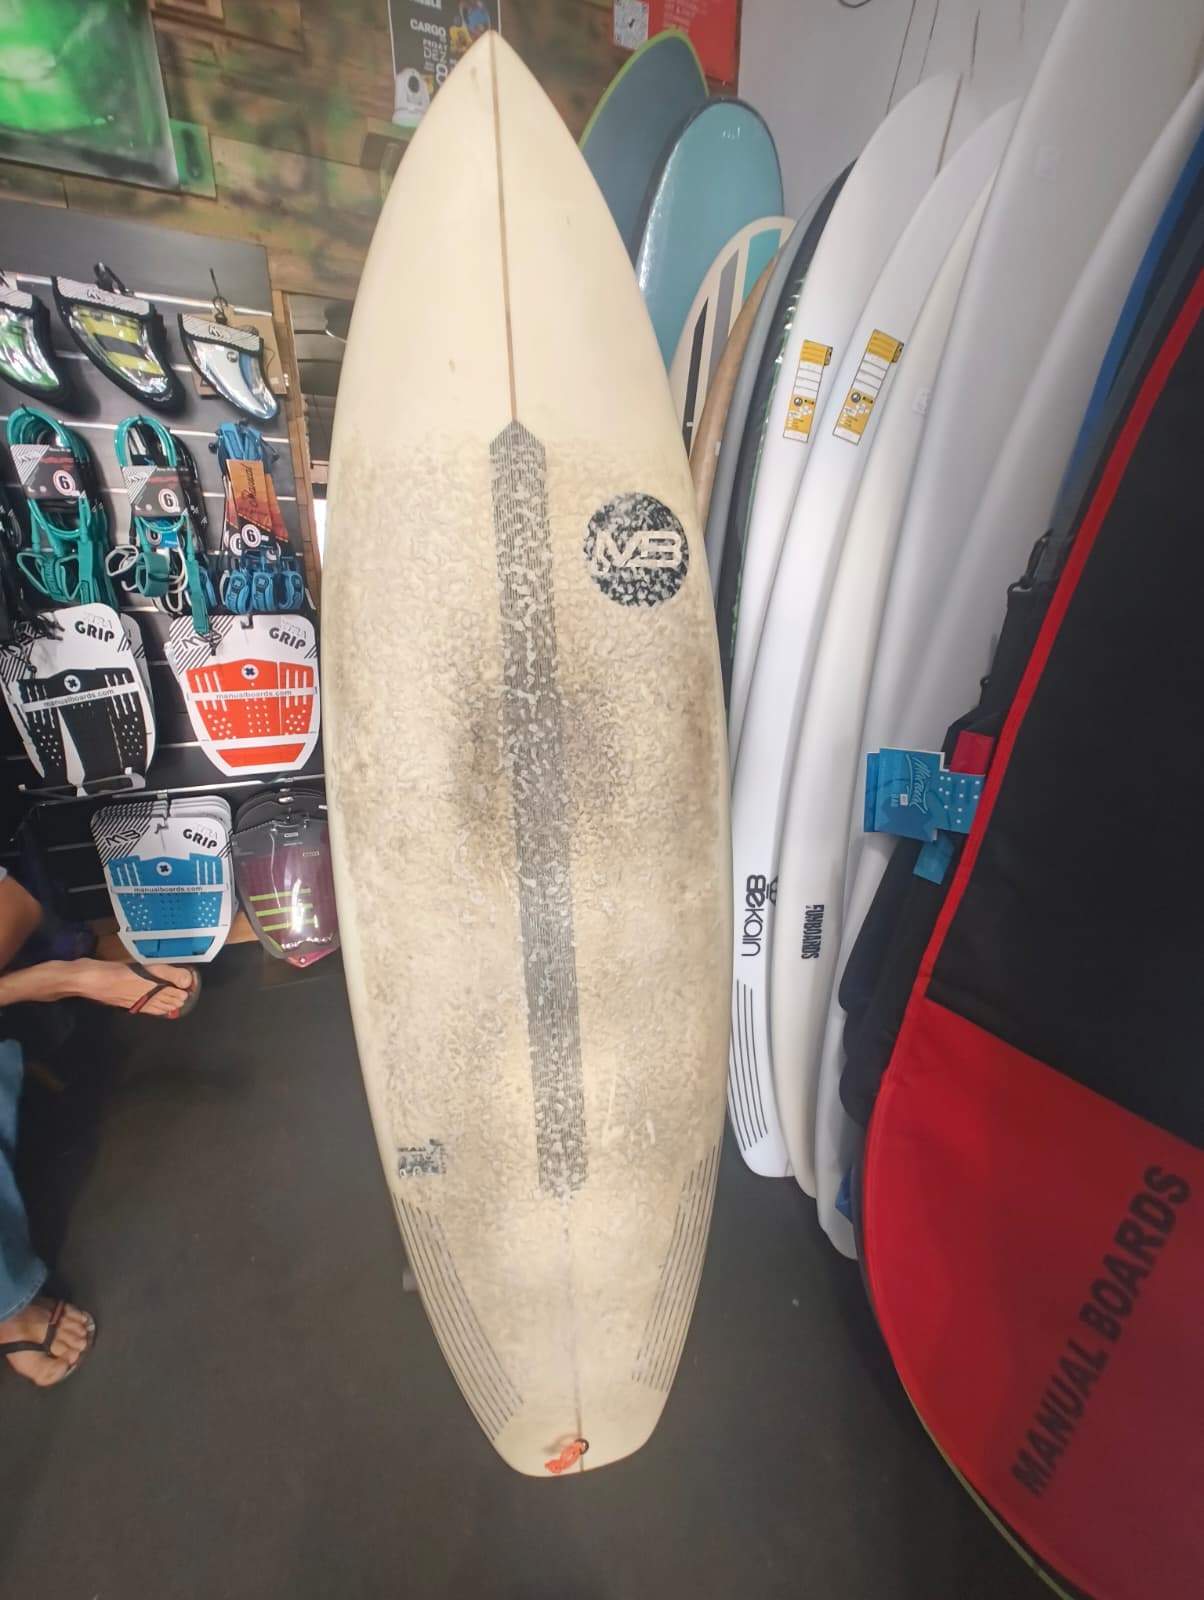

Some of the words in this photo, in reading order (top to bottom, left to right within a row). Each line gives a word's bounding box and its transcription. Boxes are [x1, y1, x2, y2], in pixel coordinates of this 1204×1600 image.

[75, 621, 114, 642] GRIP
[269, 627, 306, 650] GRIP
[183, 828, 218, 849] GRIP
[1010, 1337, 1110, 1500] MANUAL
[1079, 1164, 1191, 1343] BOARDS
